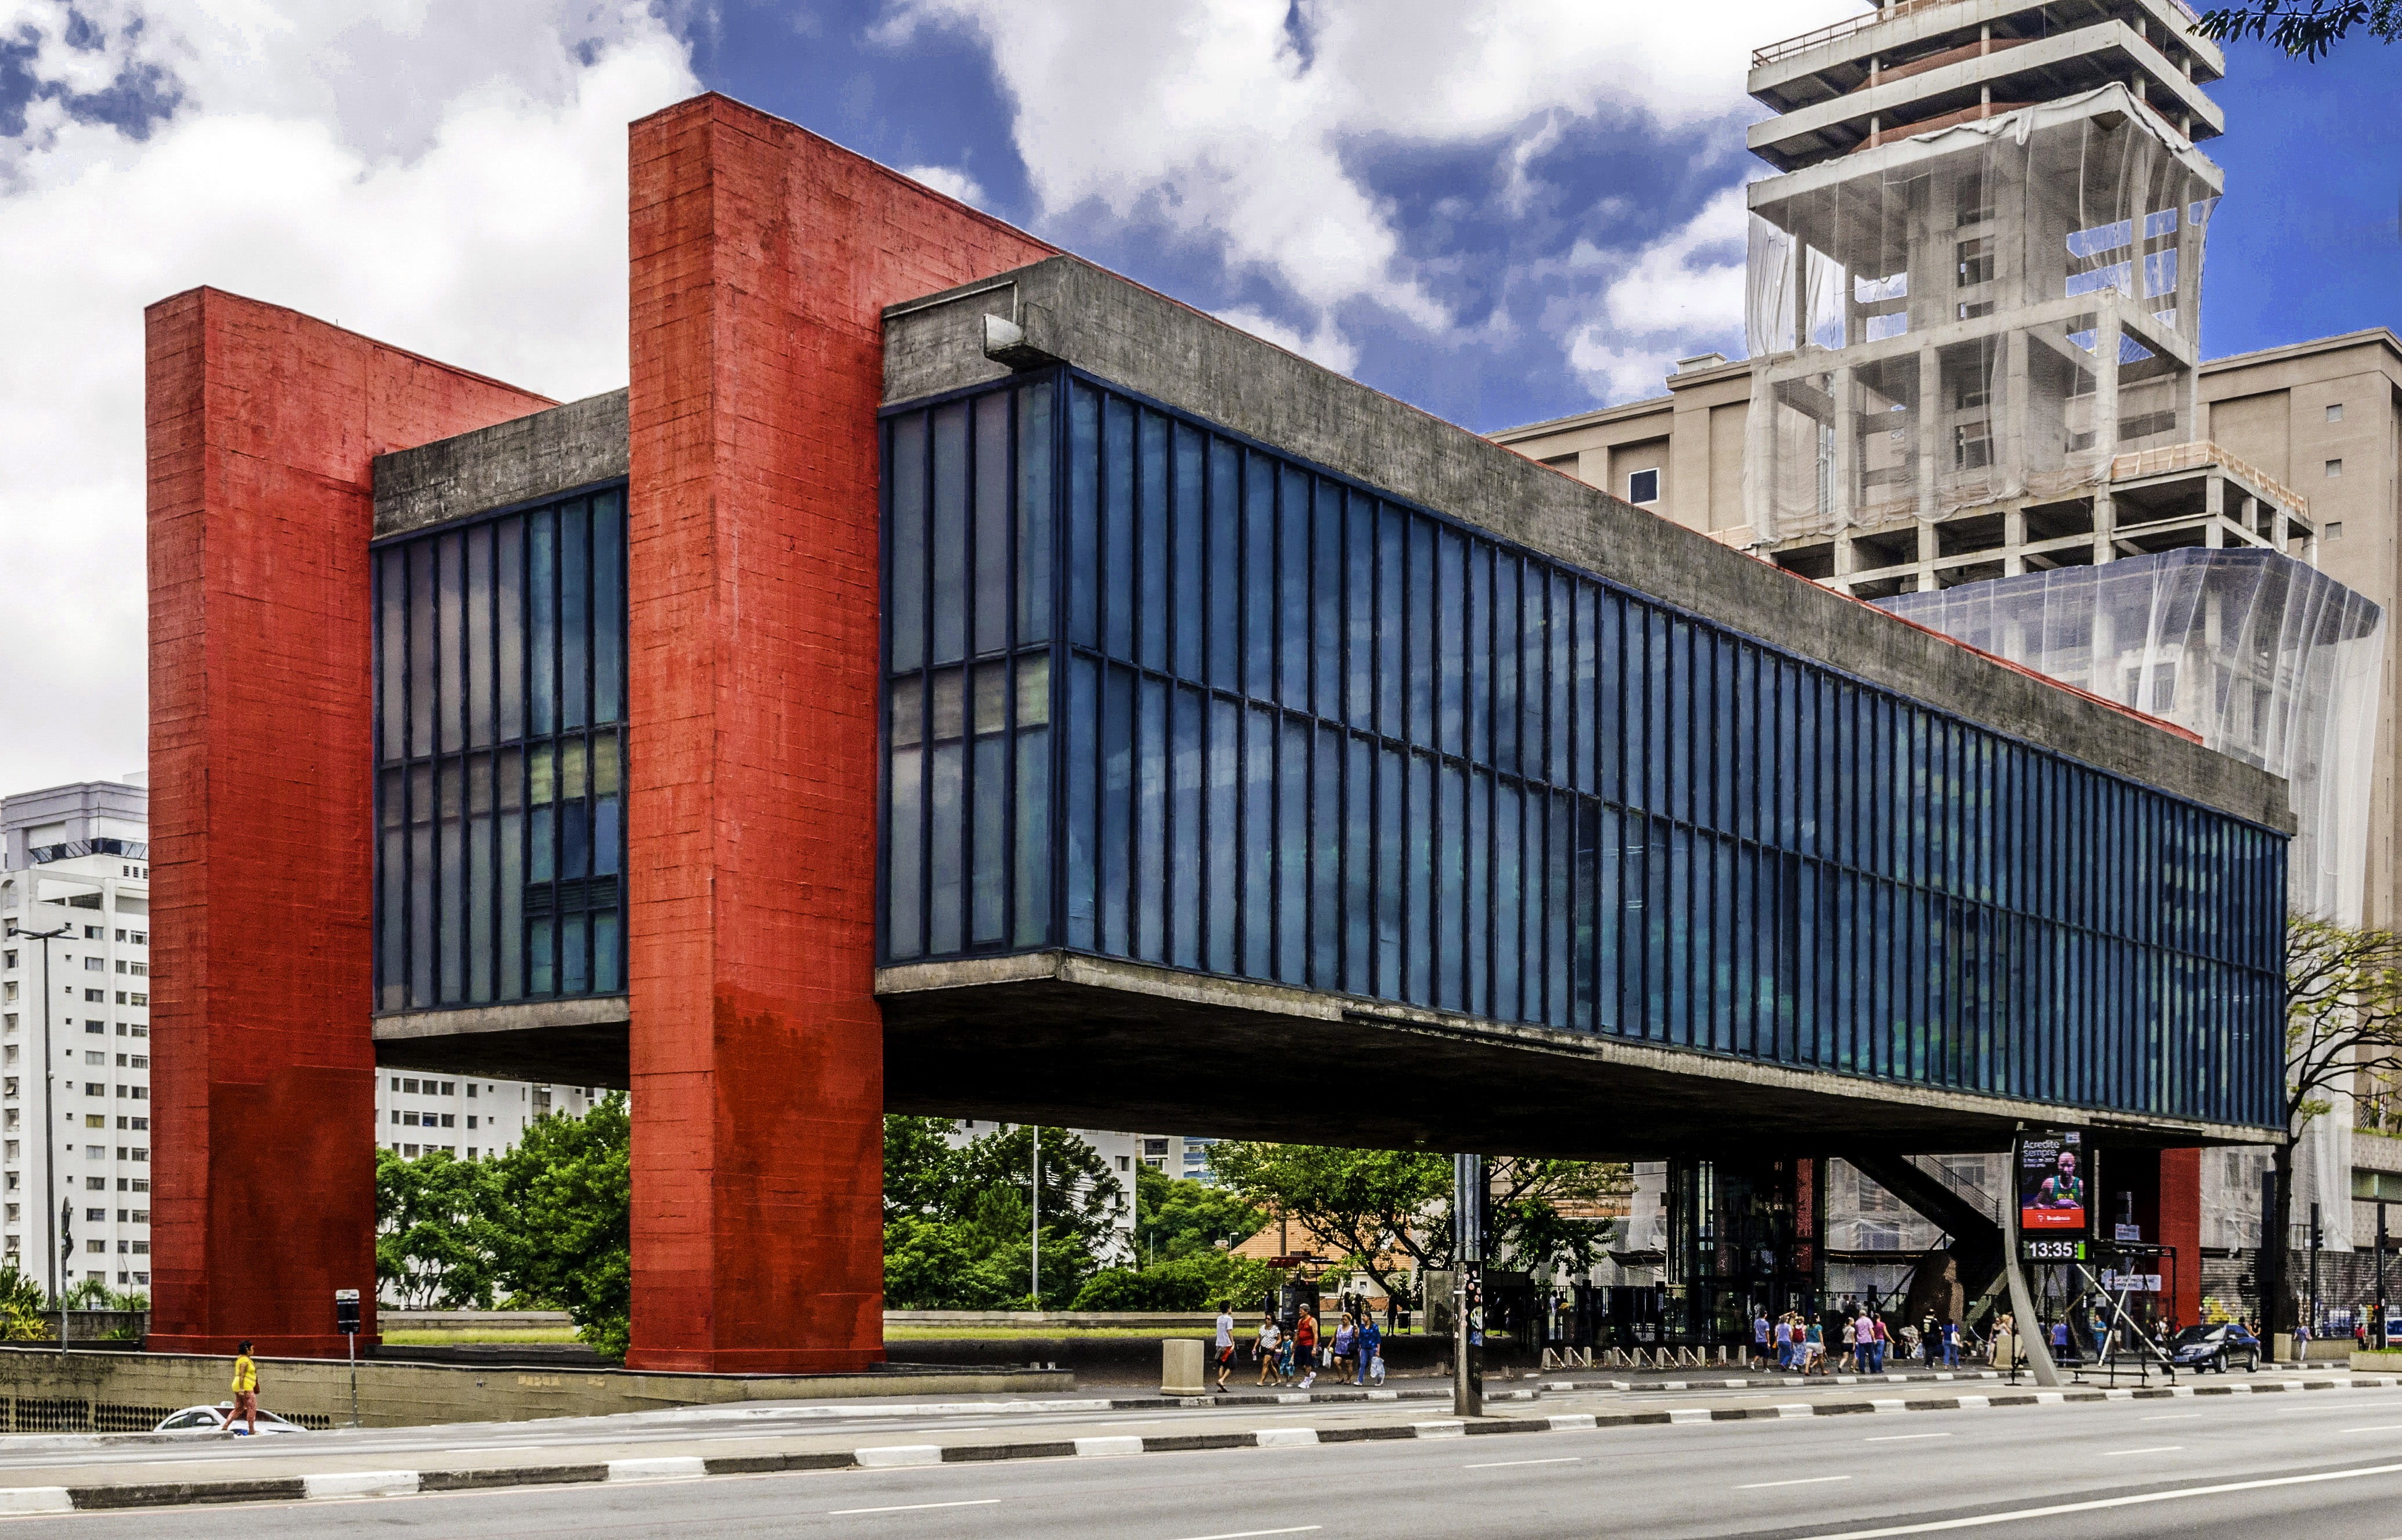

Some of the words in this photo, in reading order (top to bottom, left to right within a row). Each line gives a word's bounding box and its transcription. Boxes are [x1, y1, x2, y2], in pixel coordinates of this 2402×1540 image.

[2023, 1140, 2060, 1149] Acredite
[2023, 1149, 2058, 1158] sempre.
[2029, 1242, 2073, 1257] 13:35
